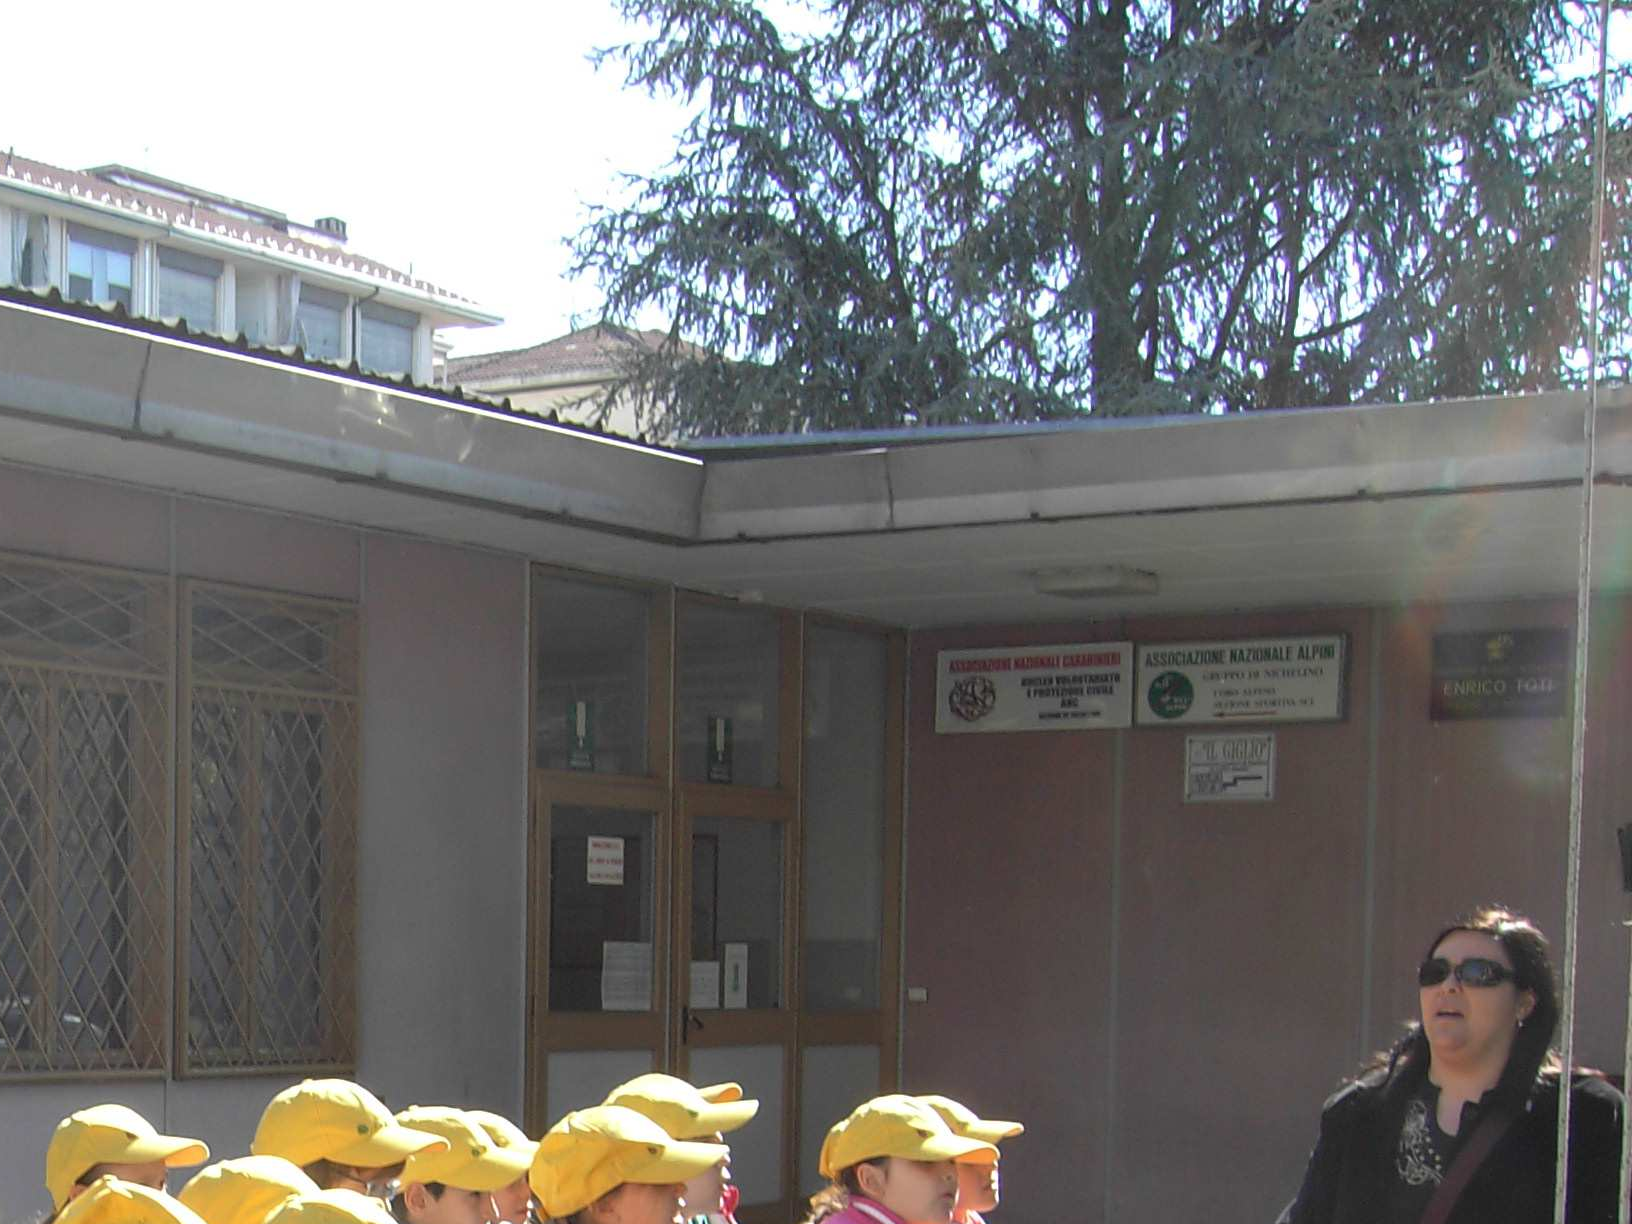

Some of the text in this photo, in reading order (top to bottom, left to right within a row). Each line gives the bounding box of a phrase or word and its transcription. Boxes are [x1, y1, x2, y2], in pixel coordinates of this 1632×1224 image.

[1145, 643, 1335, 667] ASSOCIAZIONE NAZIONALE ALPINI
[1202, 670, 1245, 681] GRUPPO
[1442, 679, 1506, 697] ENRICO
